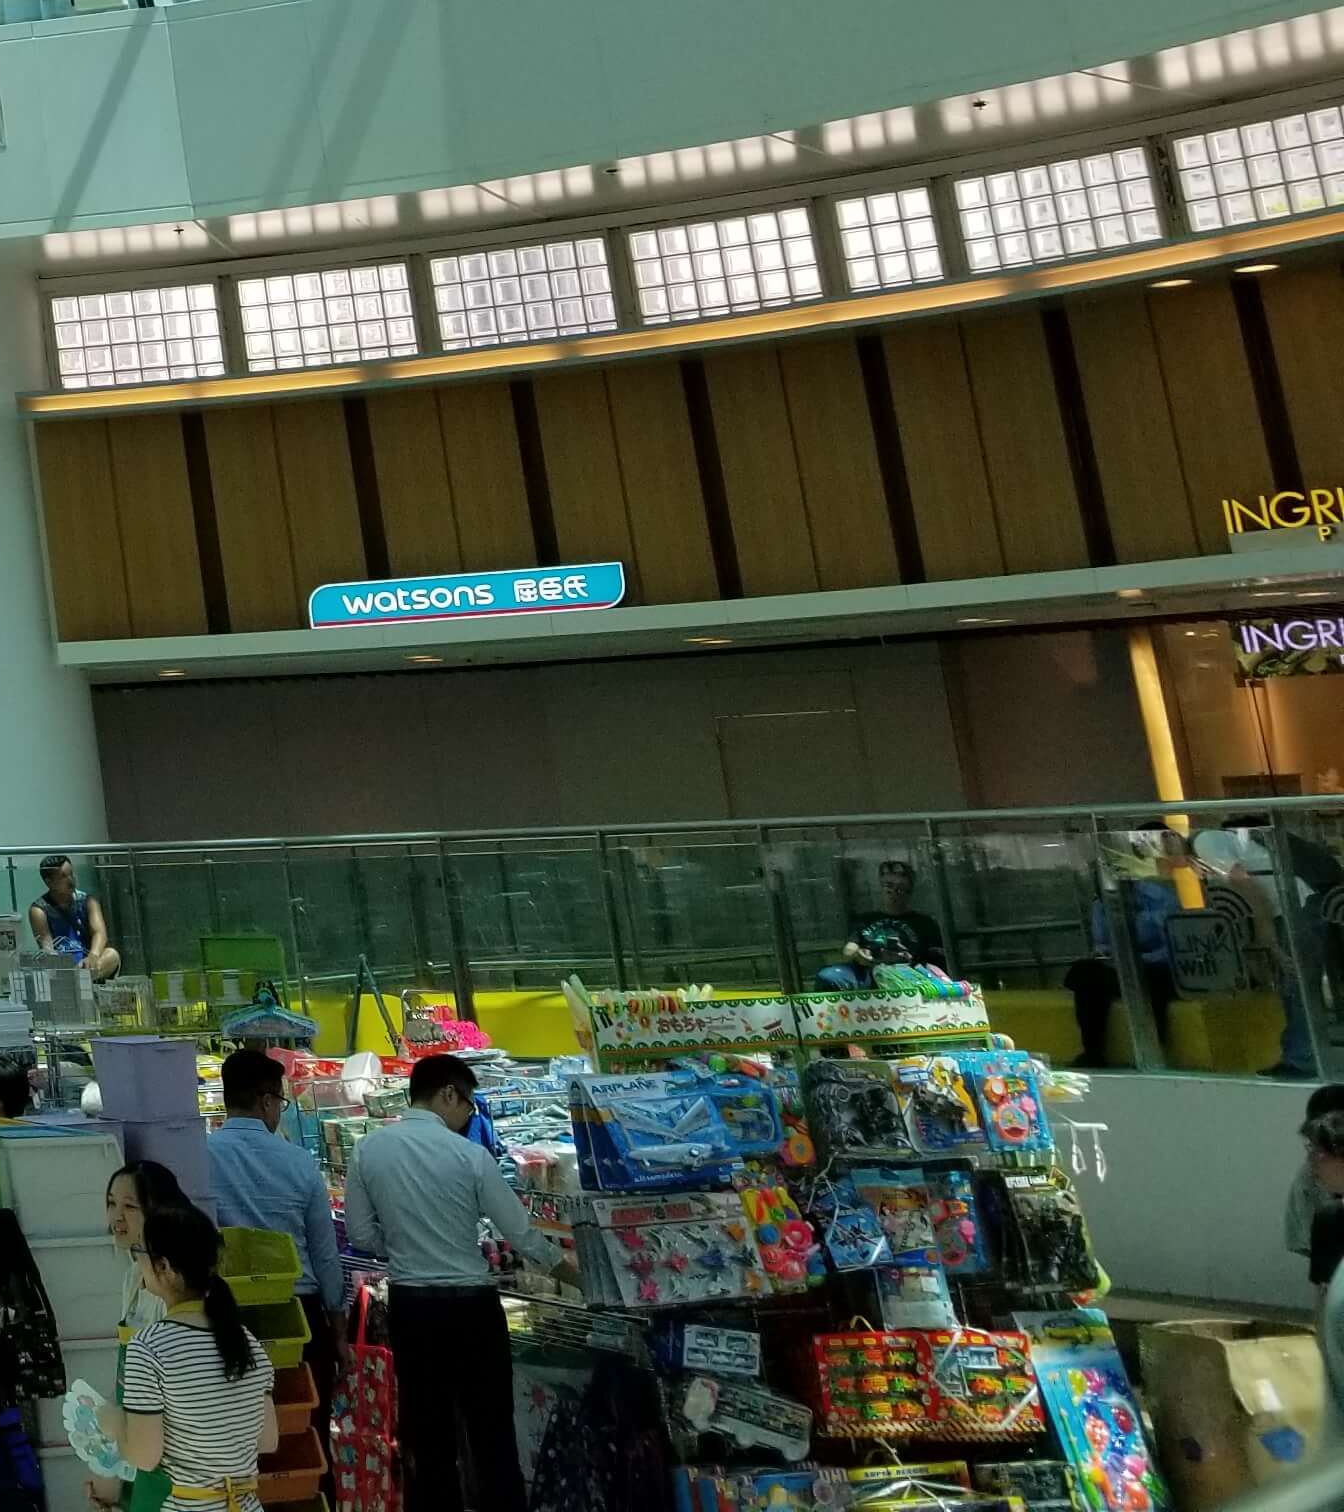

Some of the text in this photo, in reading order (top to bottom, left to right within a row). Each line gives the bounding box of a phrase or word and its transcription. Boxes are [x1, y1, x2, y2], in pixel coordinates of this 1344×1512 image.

[342, 575, 589, 616] watsons 屈臣氏
